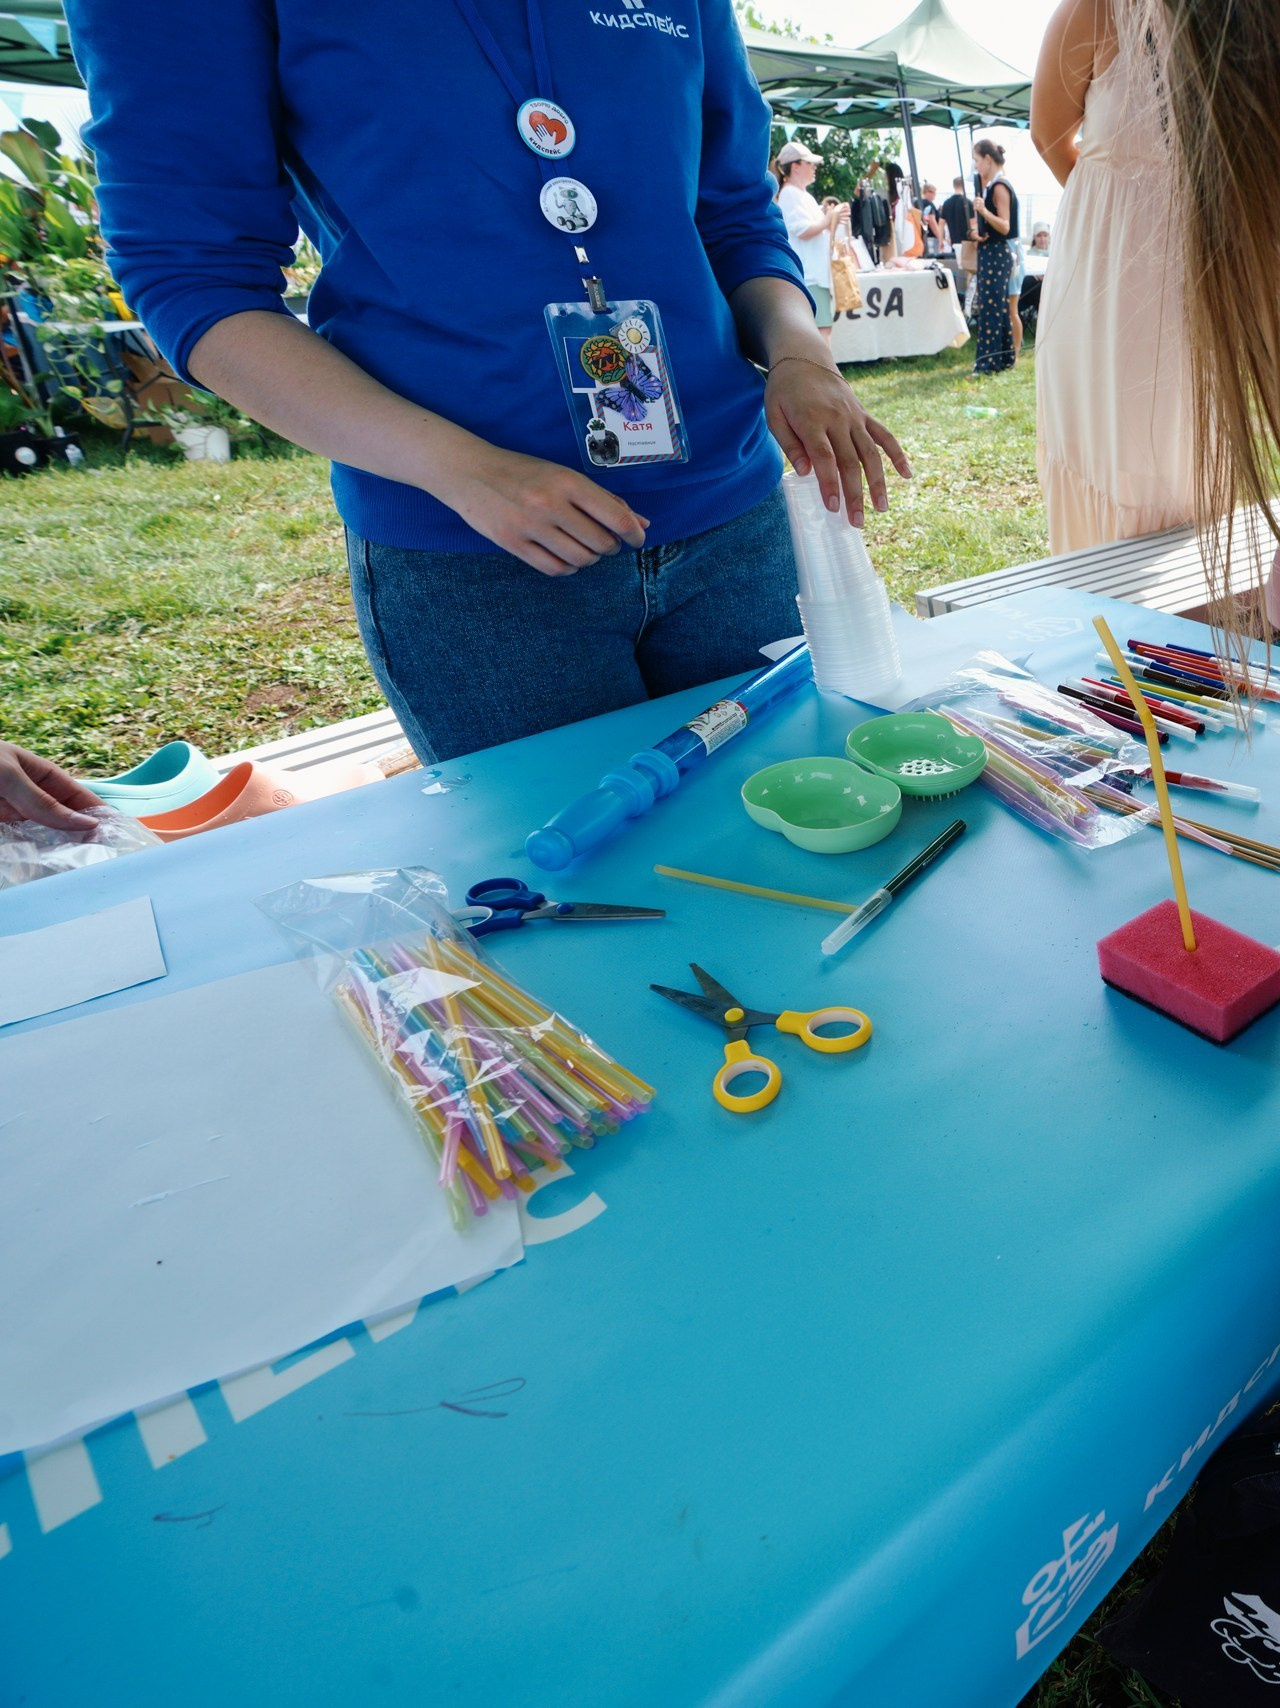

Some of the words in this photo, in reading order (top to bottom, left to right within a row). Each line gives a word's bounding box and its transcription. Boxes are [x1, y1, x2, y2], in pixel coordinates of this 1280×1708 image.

[589, 10, 689, 38] КИДСПЕЙС
[551, 106, 569, 124] ДОБРО
[529, 137, 561, 155] КИДСПЕЙС
[623, 421, 653, 432] Катя
